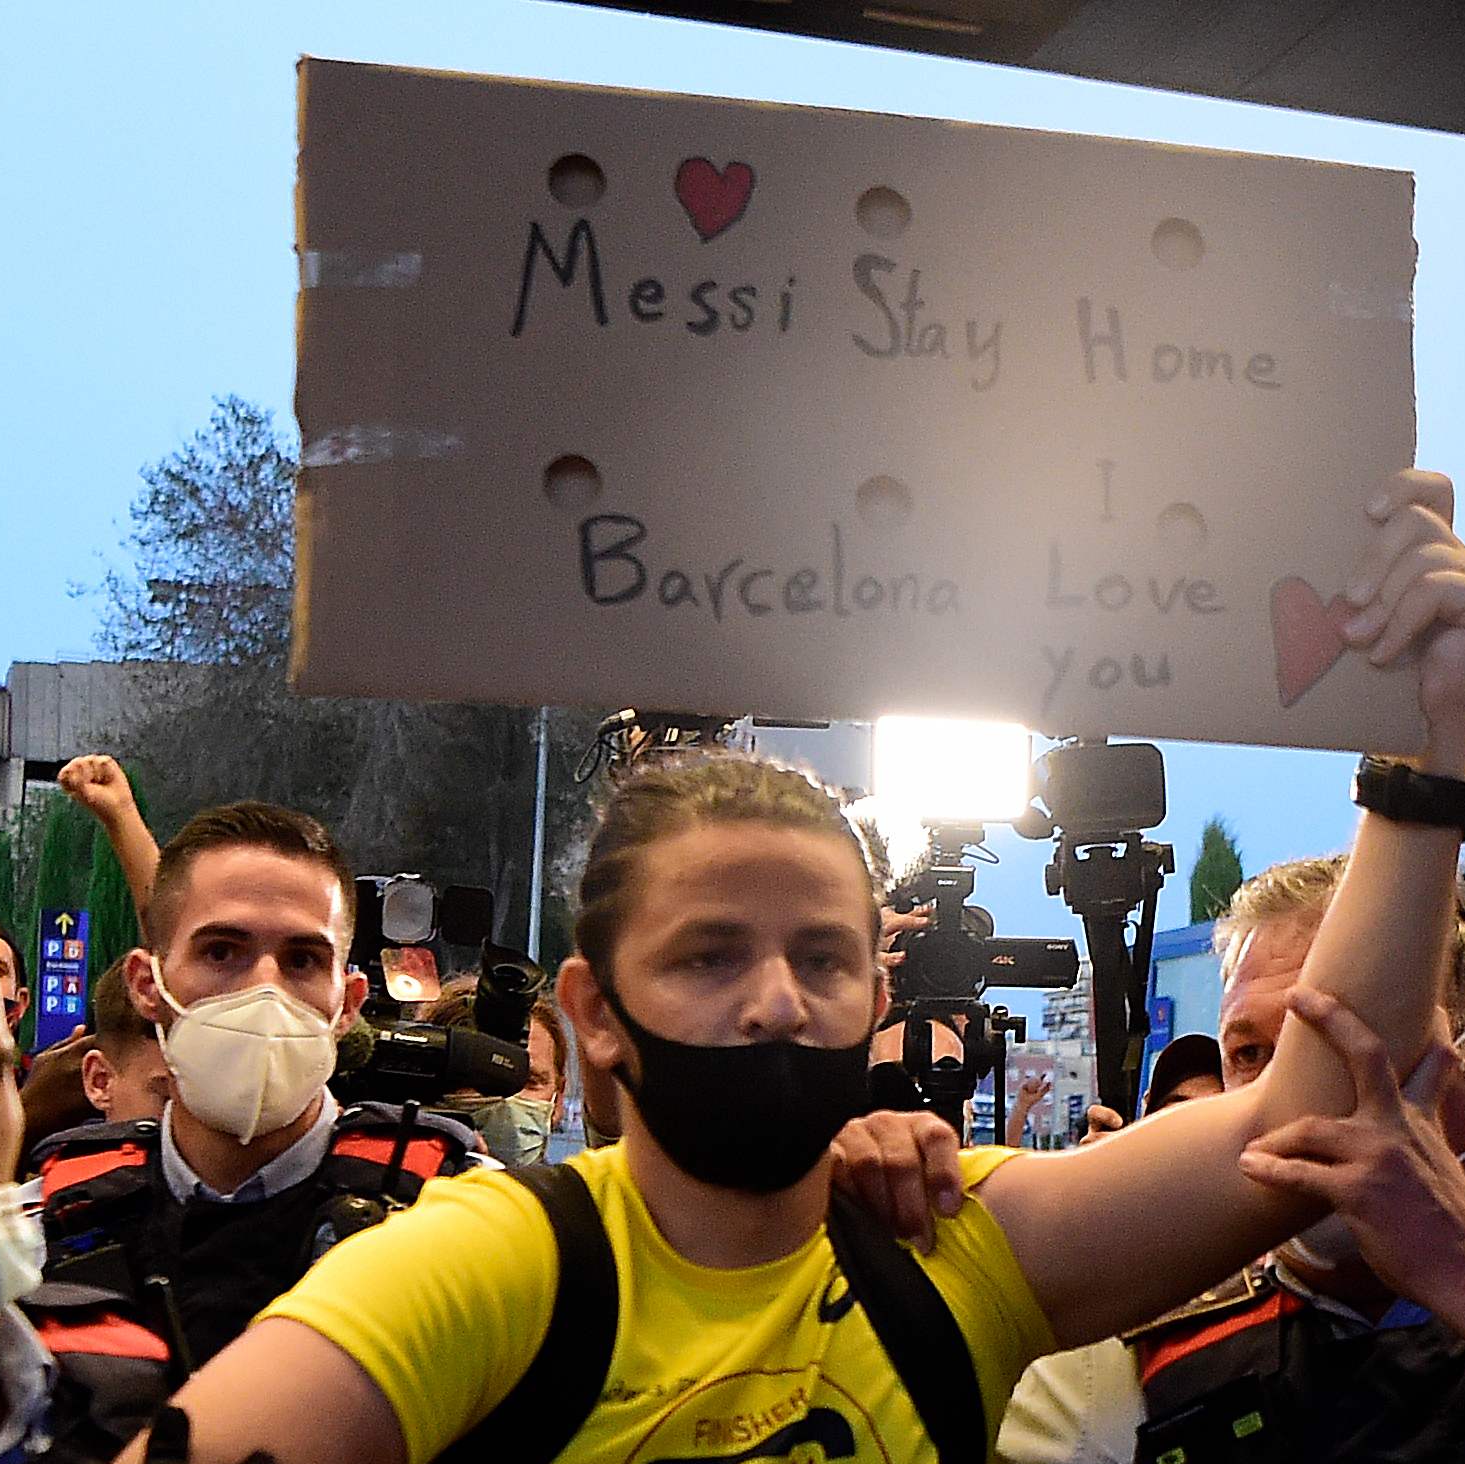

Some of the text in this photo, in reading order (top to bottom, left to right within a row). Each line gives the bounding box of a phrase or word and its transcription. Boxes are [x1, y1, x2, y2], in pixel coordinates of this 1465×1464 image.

[508, 217, 1283, 393] Messi Stay Home
[1095, 457, 1117, 524] I
[577, 512, 1226, 624] Barcelona Love
[48, 940, 60, 957] P
[46, 996, 58, 1012] P
[47, 976, 59, 993] P
